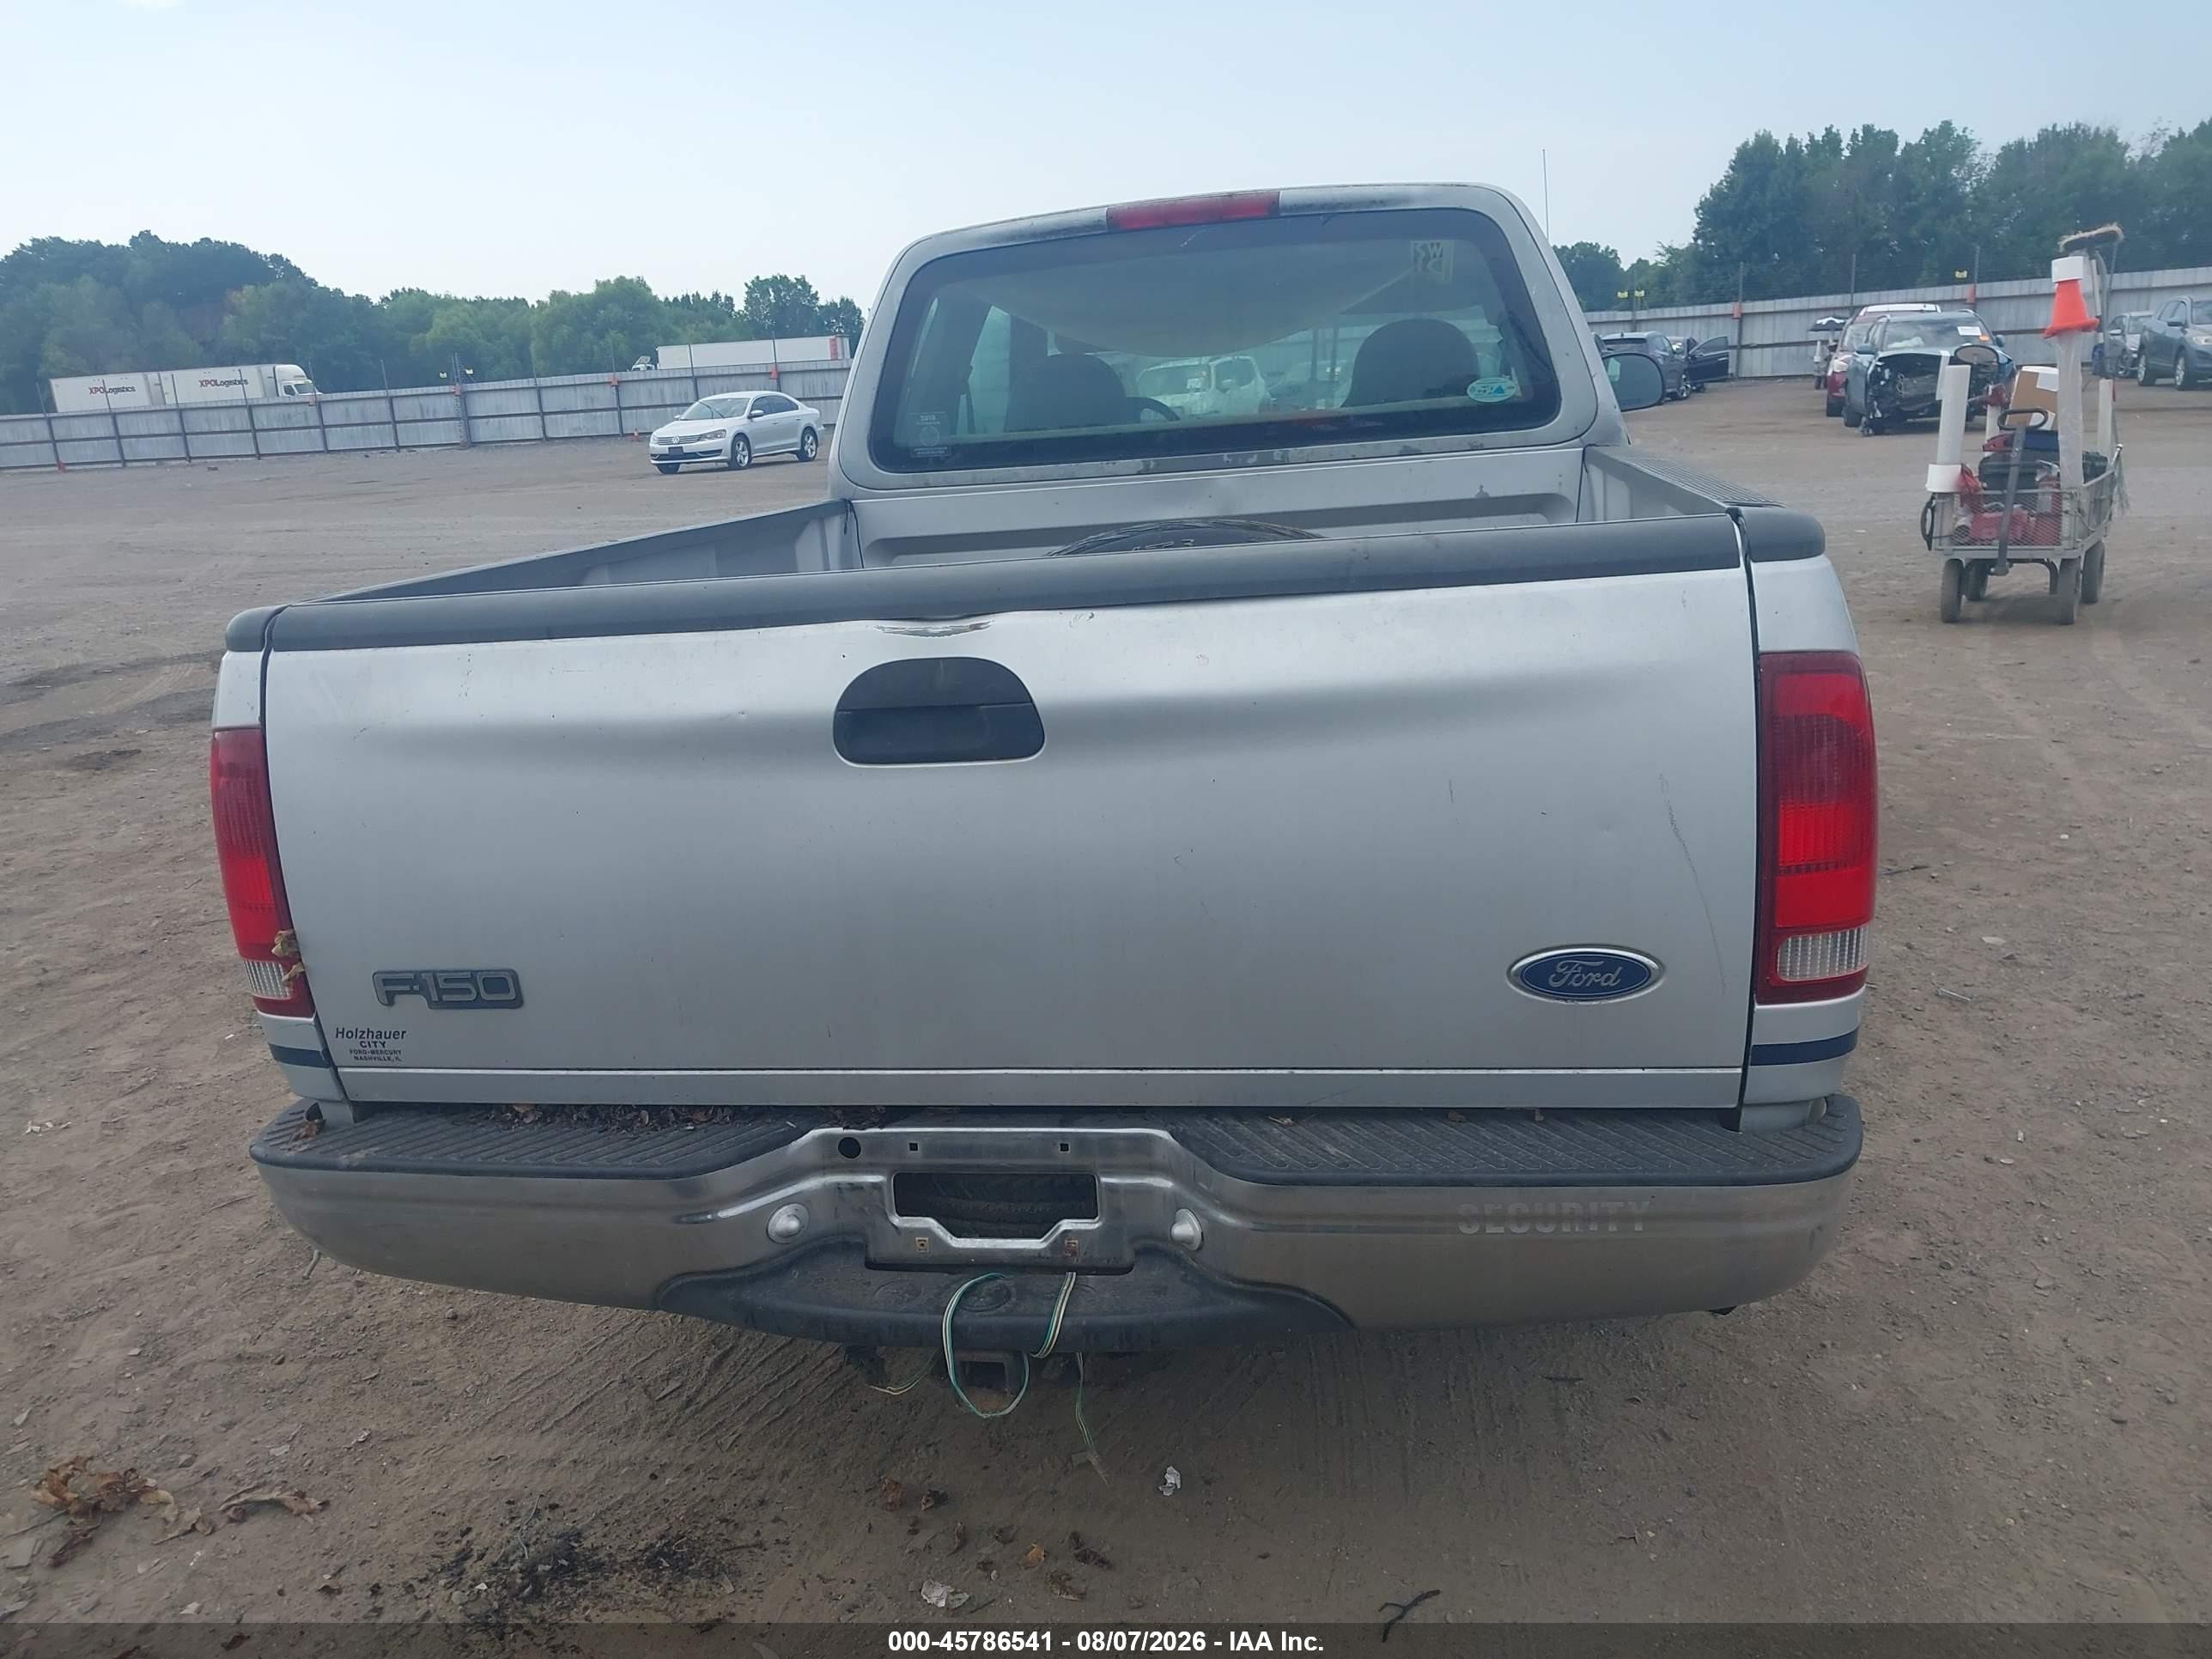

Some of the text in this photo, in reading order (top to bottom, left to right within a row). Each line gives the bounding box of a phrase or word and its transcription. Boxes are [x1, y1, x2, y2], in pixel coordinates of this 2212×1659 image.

[1548, 960, 1623, 988] Ford
[336, 1027, 406, 1040] Holzhauer
[1458, 1201, 1650, 1234] SECURITY
